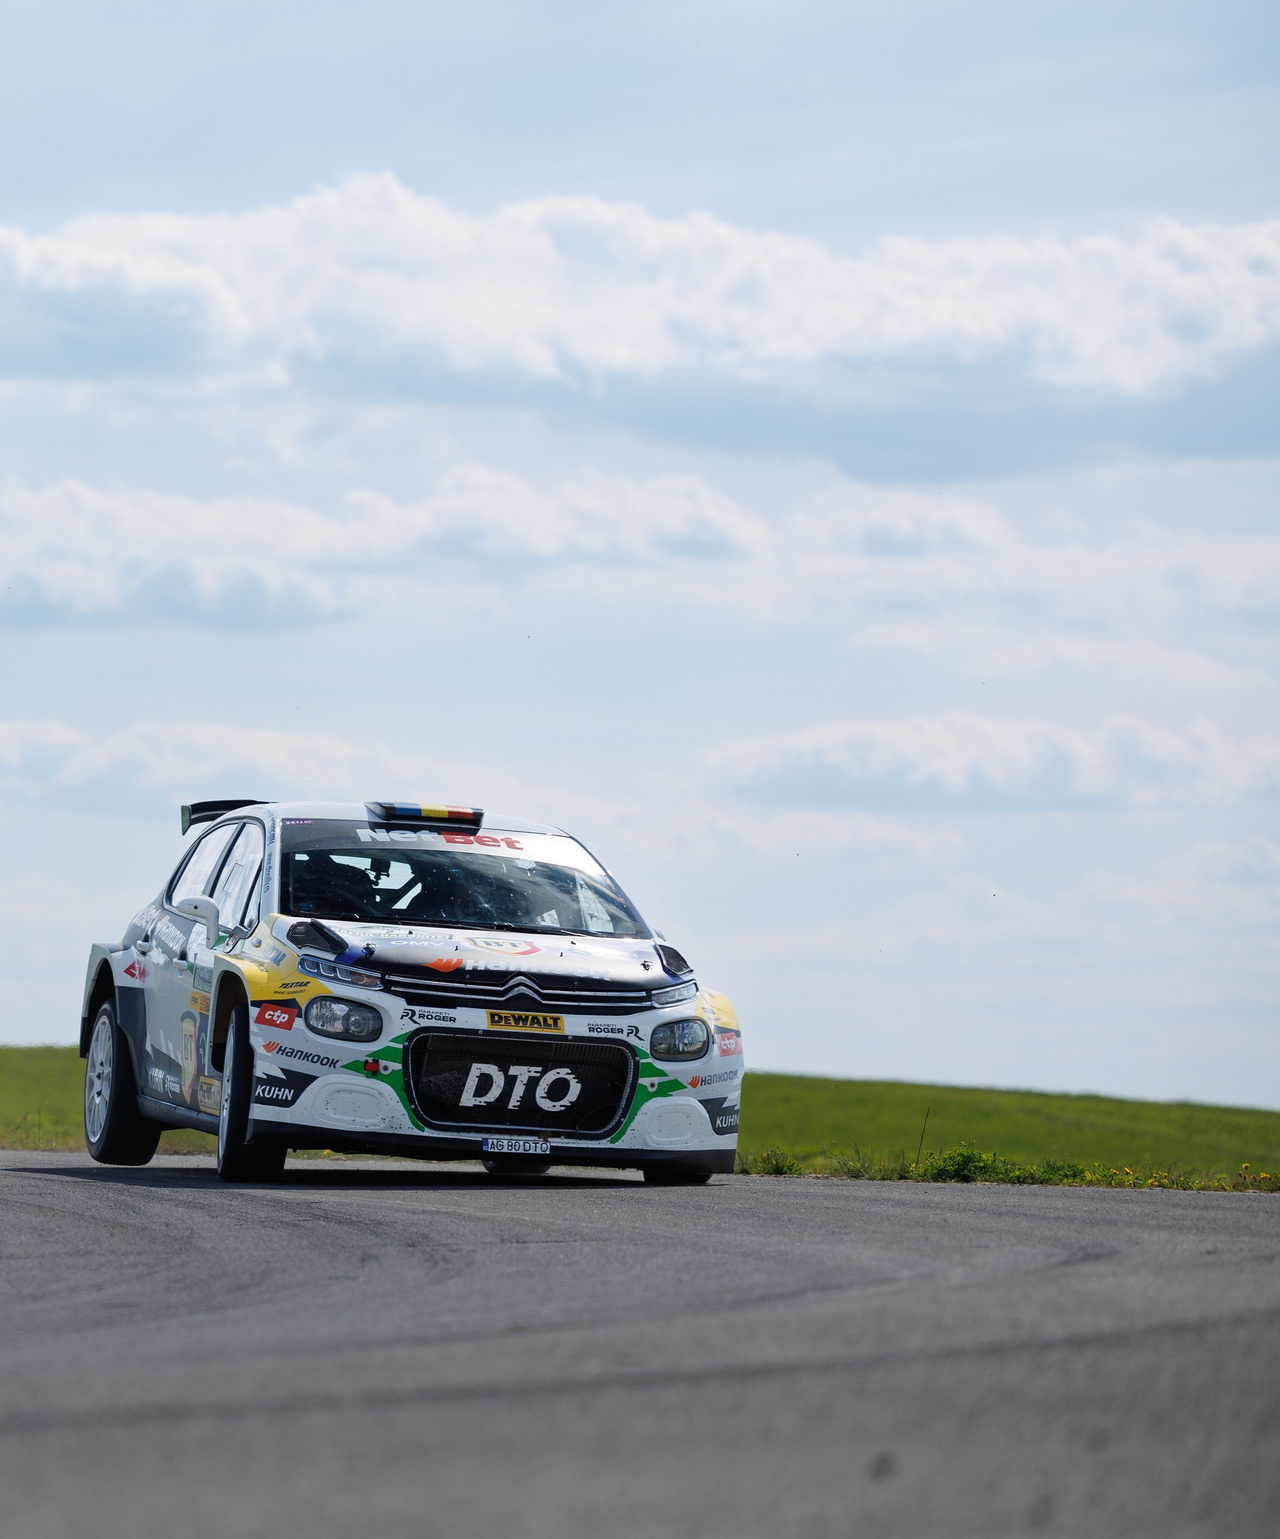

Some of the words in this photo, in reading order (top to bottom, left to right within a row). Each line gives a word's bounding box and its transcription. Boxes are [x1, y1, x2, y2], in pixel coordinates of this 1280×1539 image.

[356, 828, 524, 850] NetBet
[264, 1010, 289, 1024] ctp
[418, 1013, 457, 1023] ROGER
[588, 1027, 624, 1035] ROGER
[721, 1037, 736, 1051] ctp
[255, 1085, 295, 1101] KUHN
[458, 1063, 582, 1112] DTO
[716, 1114, 740, 1128] KUHN
[490, 1140, 504, 1151] AG
[507, 1141, 520, 1152] 80
[523, 1142, 549, 1153] DTO
